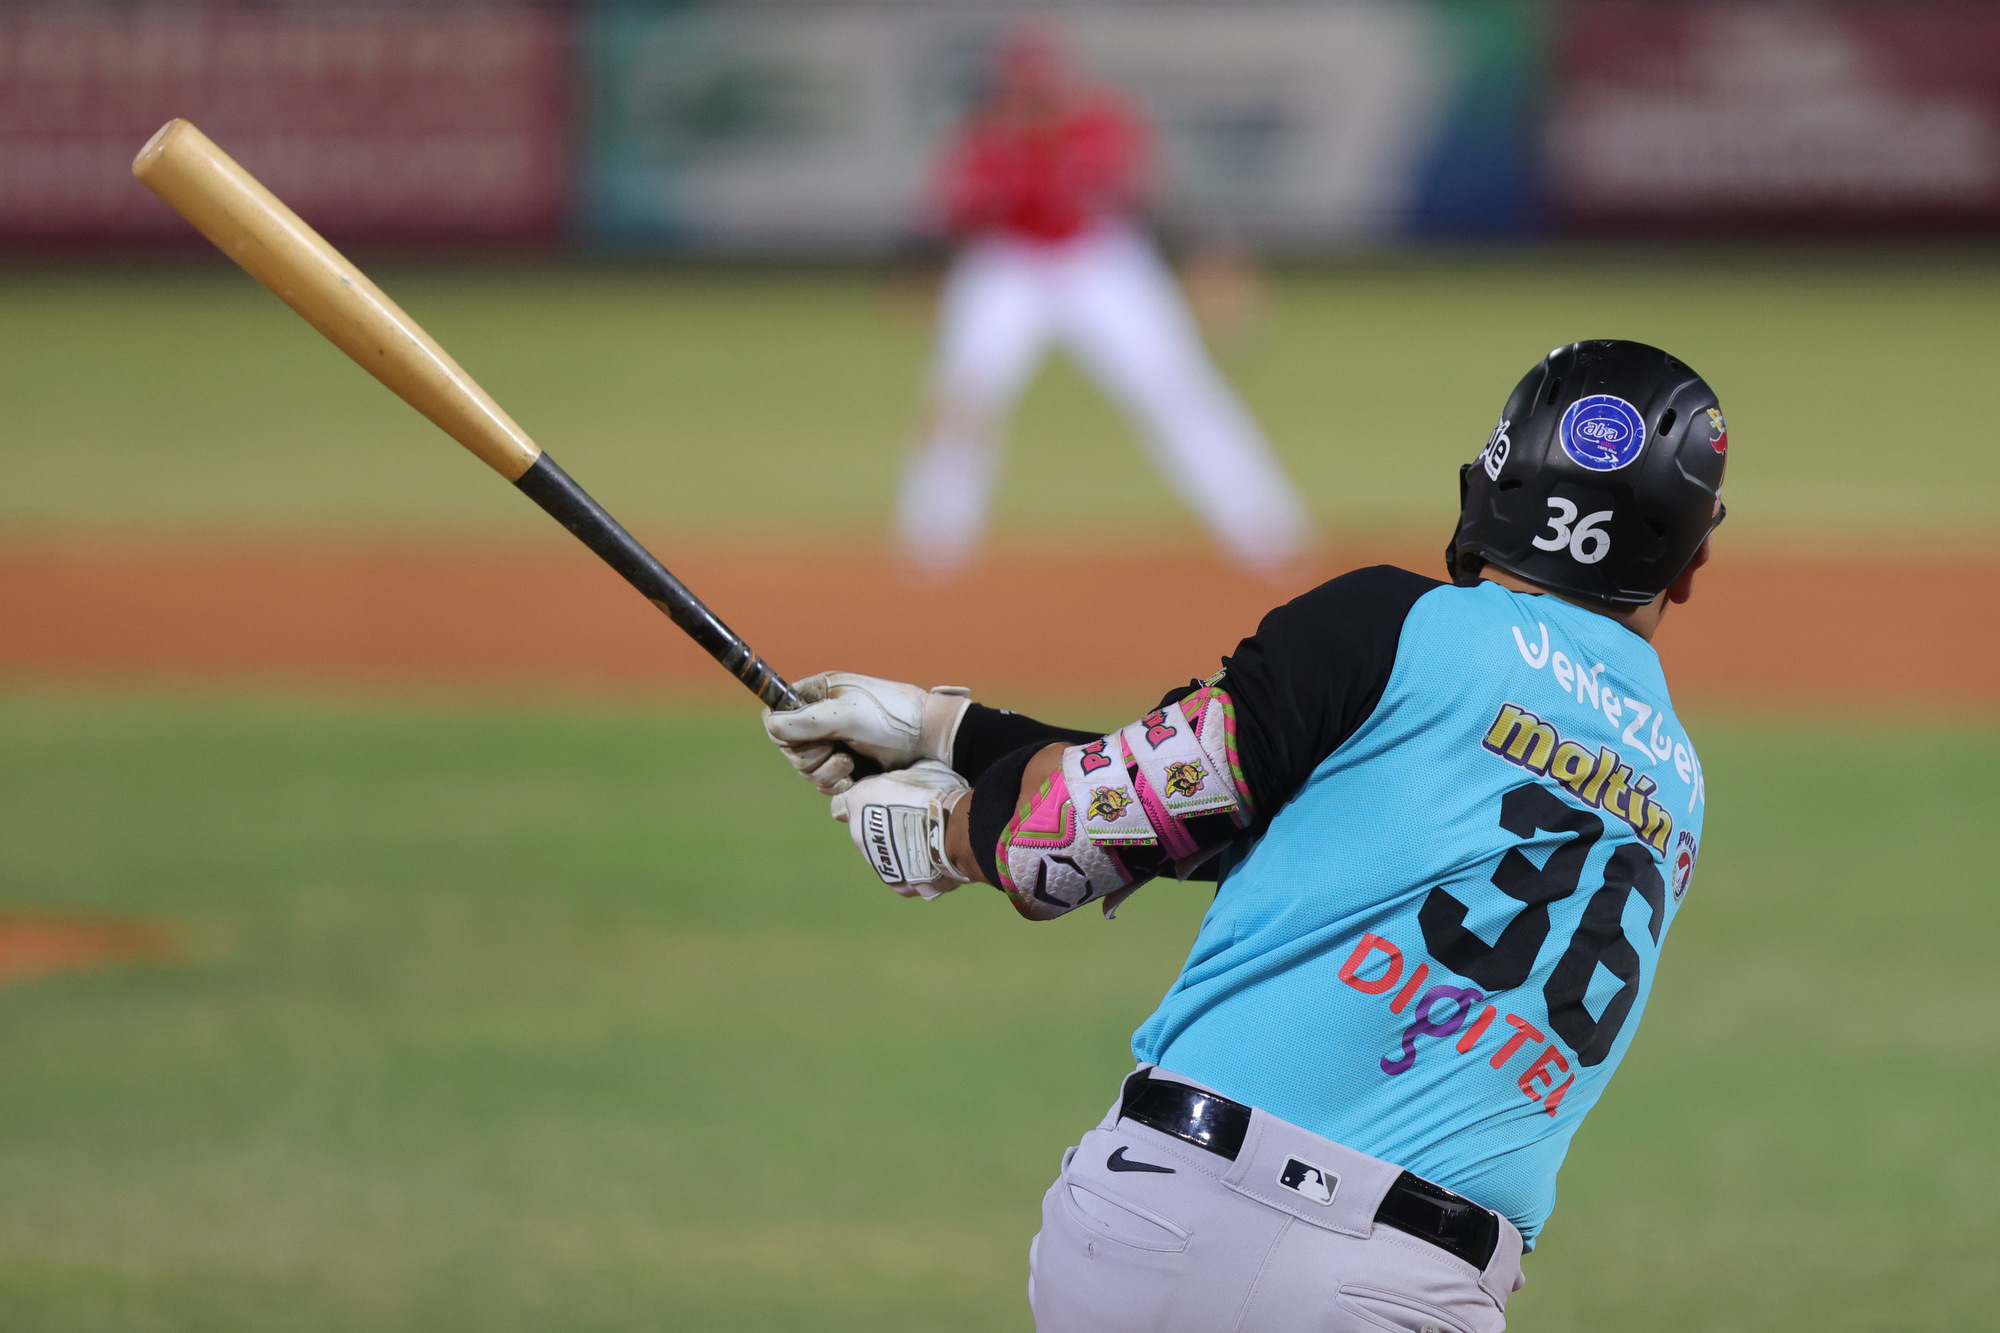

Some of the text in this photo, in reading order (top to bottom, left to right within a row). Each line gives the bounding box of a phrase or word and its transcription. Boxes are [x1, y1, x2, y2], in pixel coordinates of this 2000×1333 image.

[1583, 421, 1618, 442] aba
[1531, 496, 1614, 564] 36
[1482, 702, 1674, 861] maltin
[1417, 781, 1666, 1068] 36
